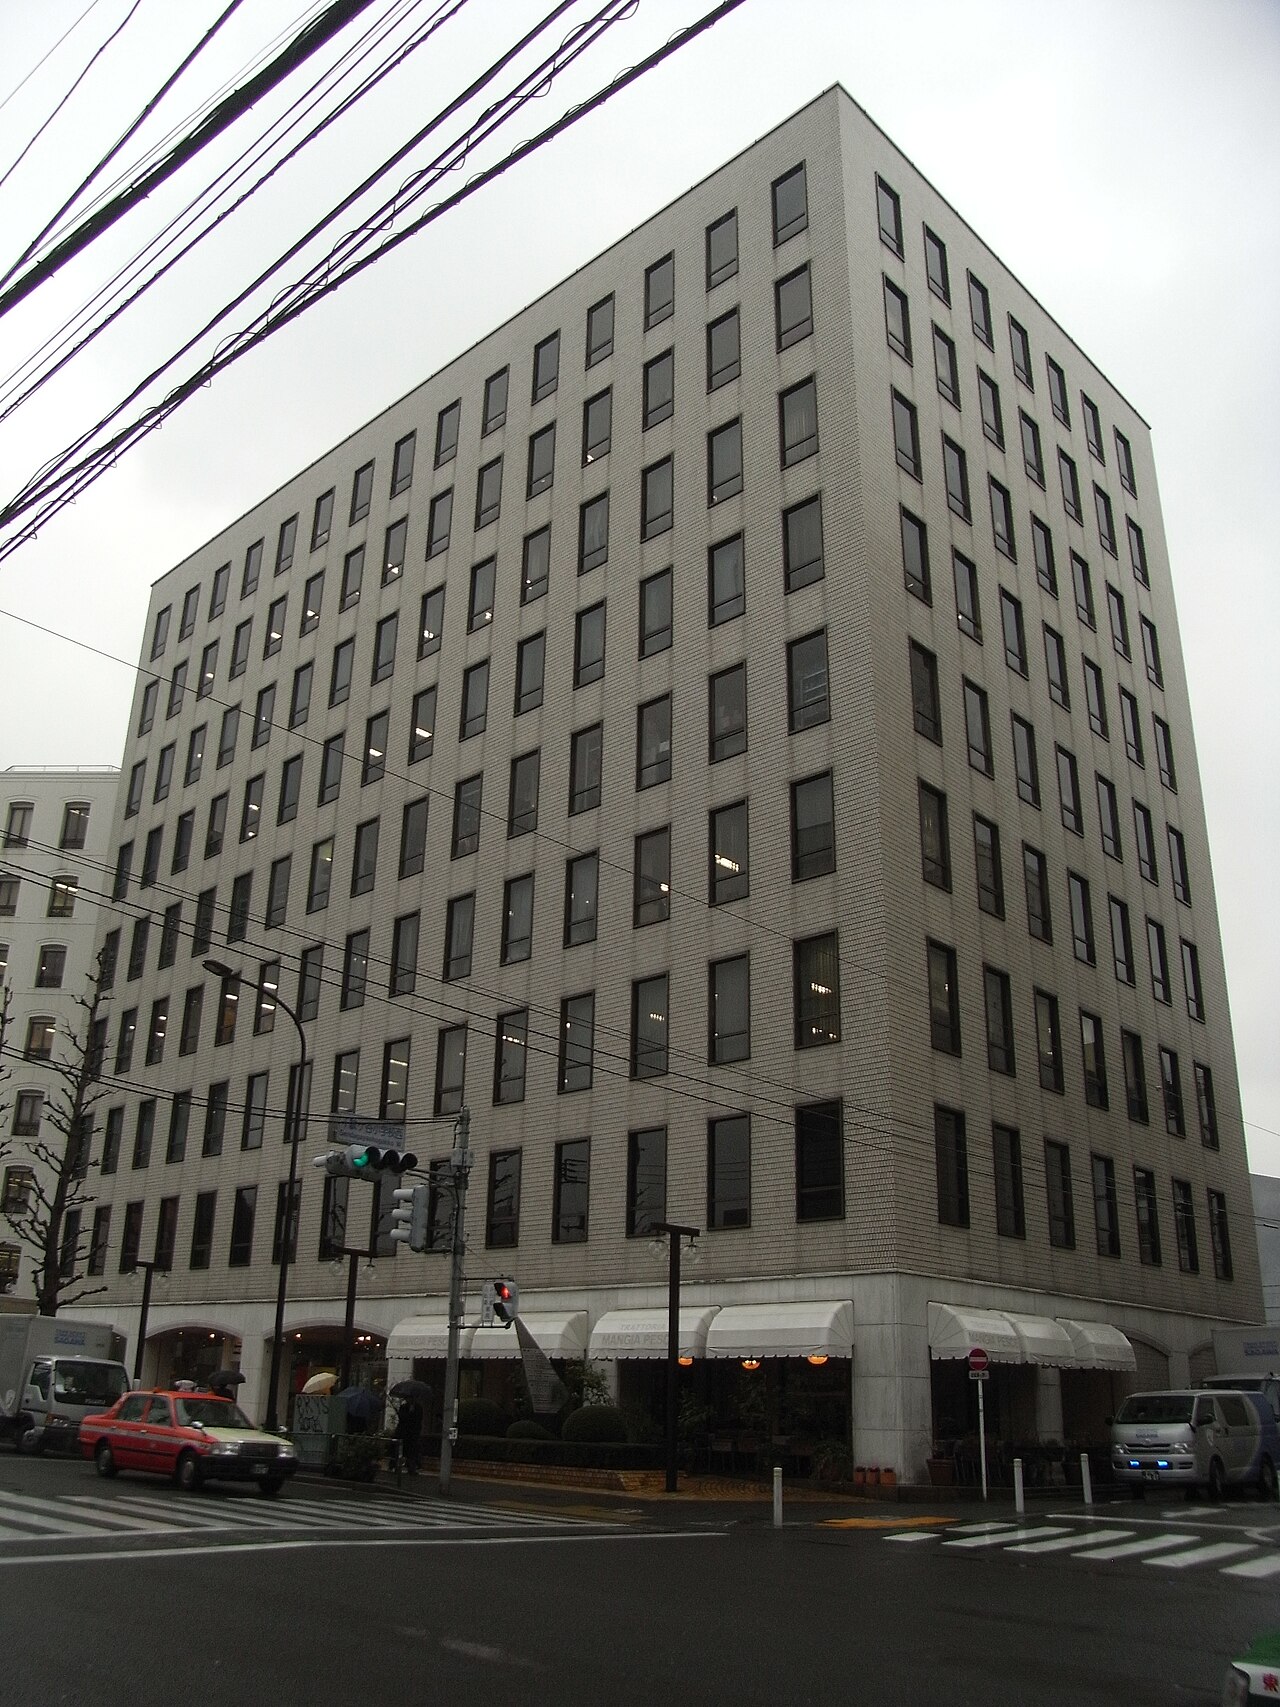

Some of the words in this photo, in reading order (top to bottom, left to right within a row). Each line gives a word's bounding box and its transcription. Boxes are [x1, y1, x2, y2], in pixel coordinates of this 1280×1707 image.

[427, 1335, 450, 1346] PESC
[602, 1334, 640, 1345] MANGIA
[643, 1333, 669, 1345] PESC
